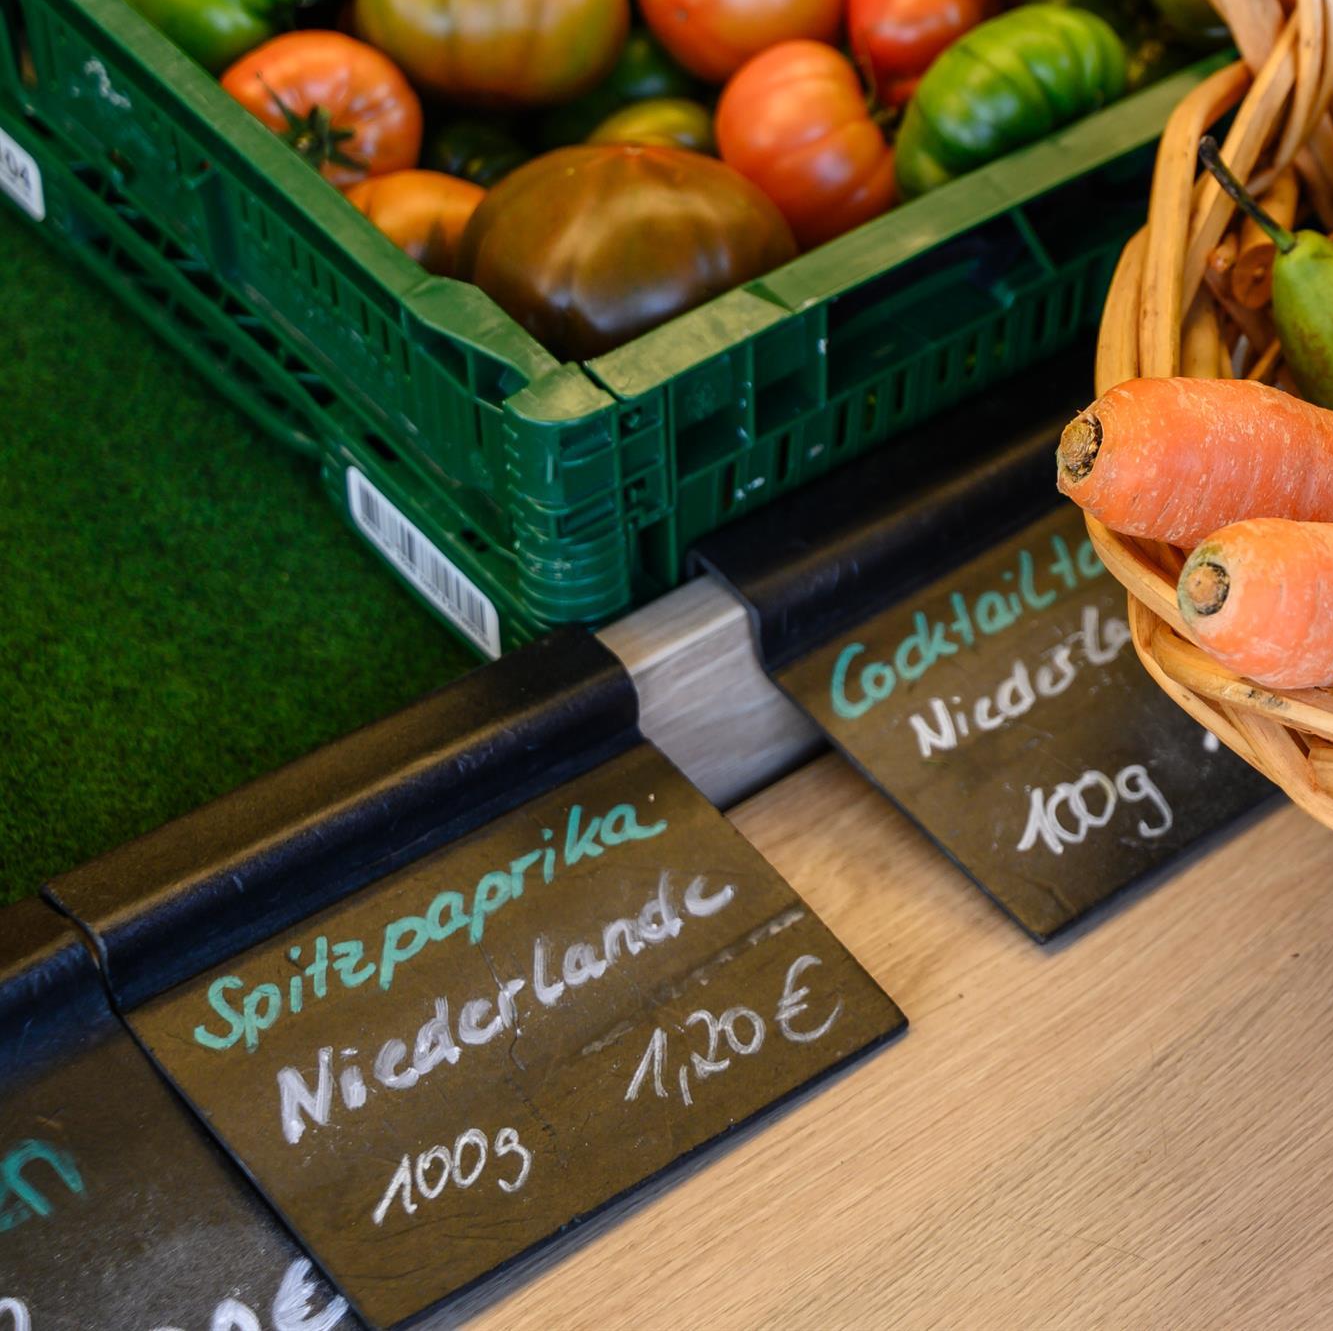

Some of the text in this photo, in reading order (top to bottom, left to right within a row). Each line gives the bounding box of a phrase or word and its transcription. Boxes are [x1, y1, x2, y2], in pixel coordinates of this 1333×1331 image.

[907, 606, 1132, 759] Niederla
[1015, 764, 1173, 855] 100g
[194, 803, 668, 1054] Spitzpaprika
[276, 872, 736, 1146] Niederlande
[372, 1126, 532, 1225] 100g
